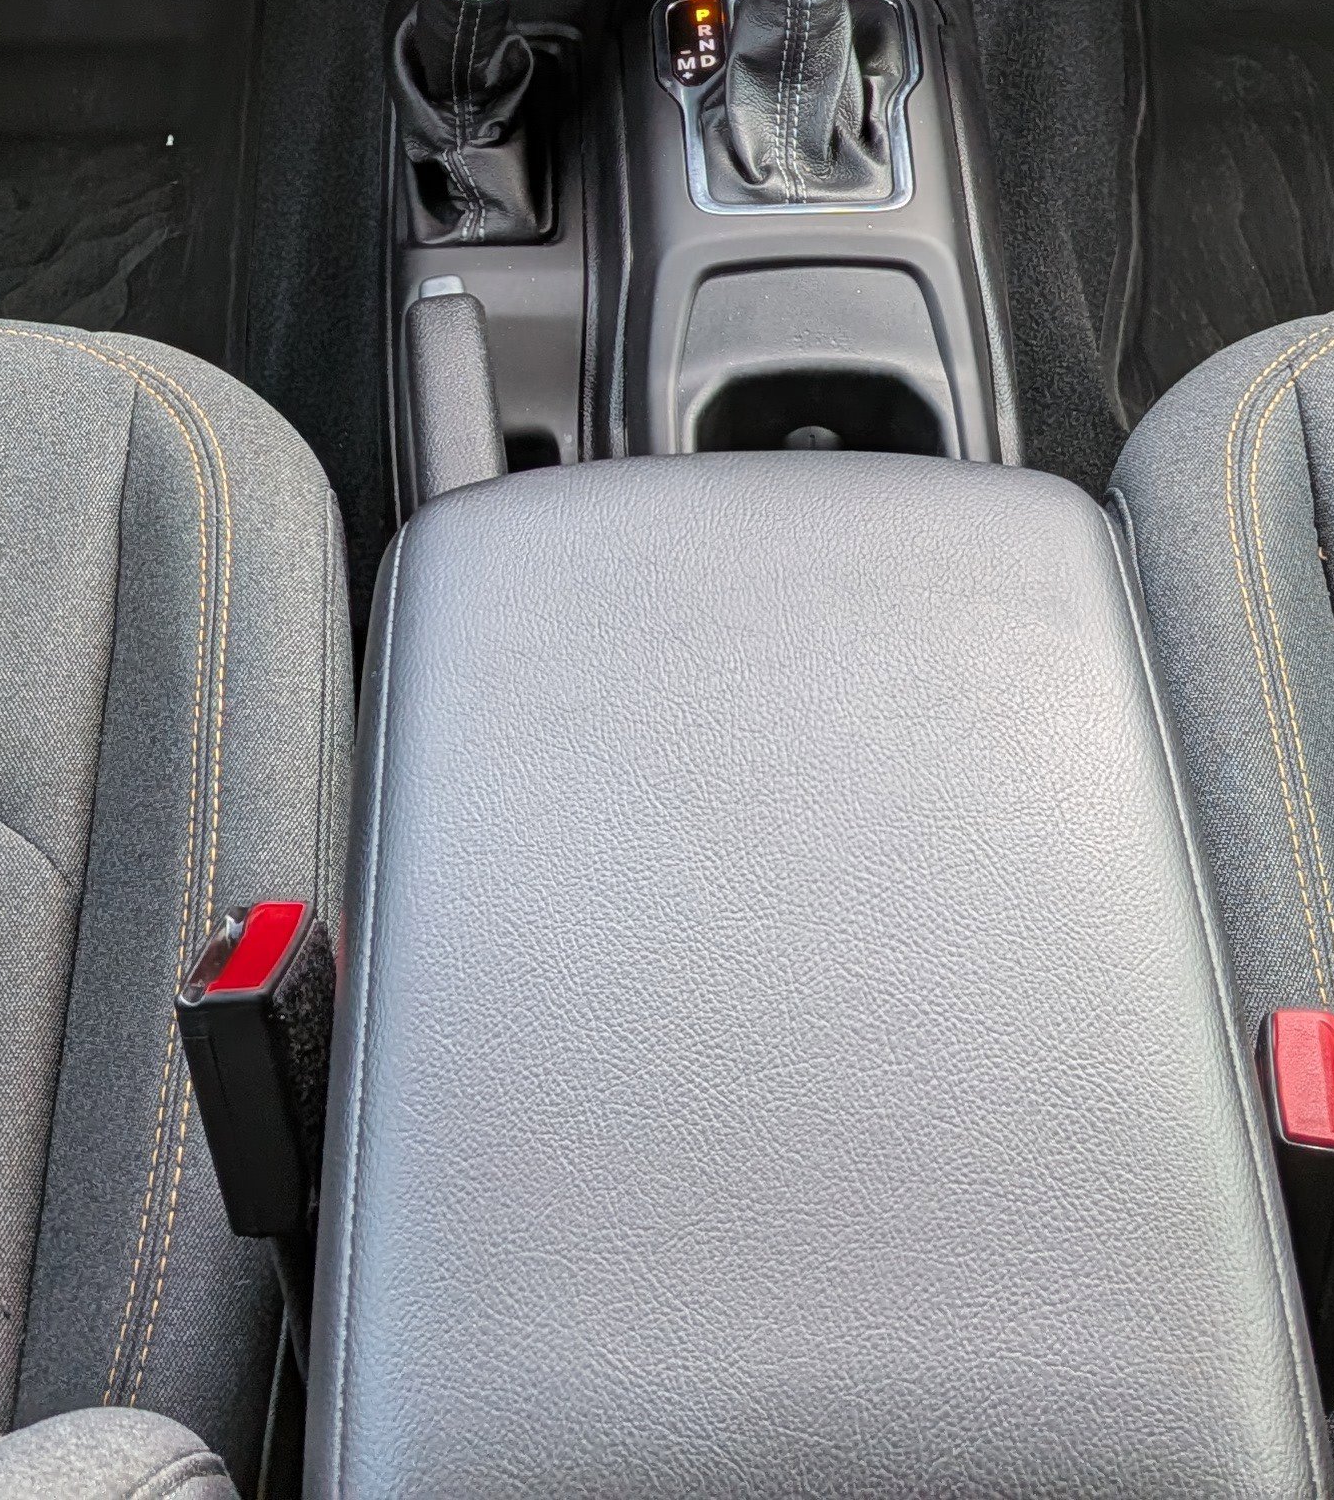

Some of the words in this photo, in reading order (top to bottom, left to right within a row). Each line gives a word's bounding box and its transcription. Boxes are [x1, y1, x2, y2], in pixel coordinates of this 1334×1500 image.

[695, 8, 710, 22] P
[697, 24, 713, 37] R
[699, 38, 716, 52] N
[677, 56, 696, 71] M
[700, 54, 717, 68] D
